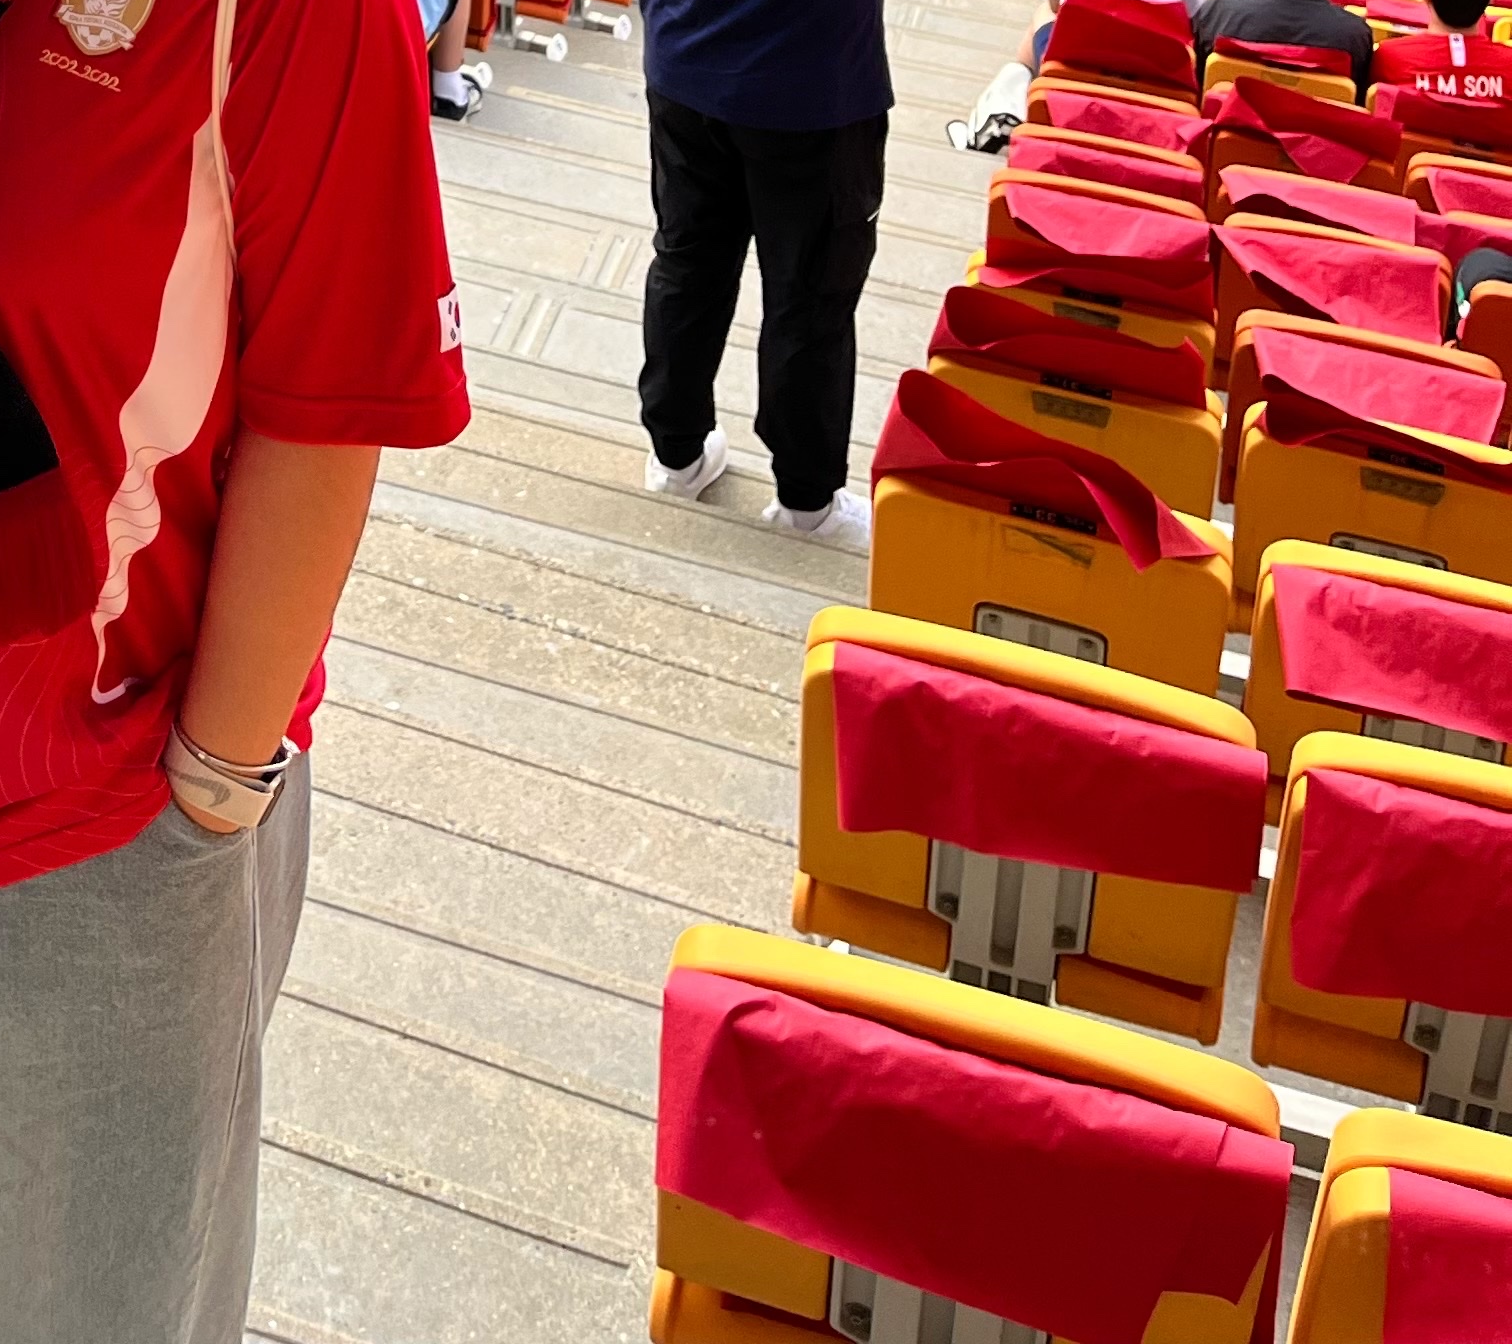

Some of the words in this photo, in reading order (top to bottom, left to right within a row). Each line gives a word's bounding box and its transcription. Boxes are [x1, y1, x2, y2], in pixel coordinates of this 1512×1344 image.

[1415, 73, 1430, 91] H
[1437, 74, 1457, 96] M
[1464, 75, 1503, 98] SON
